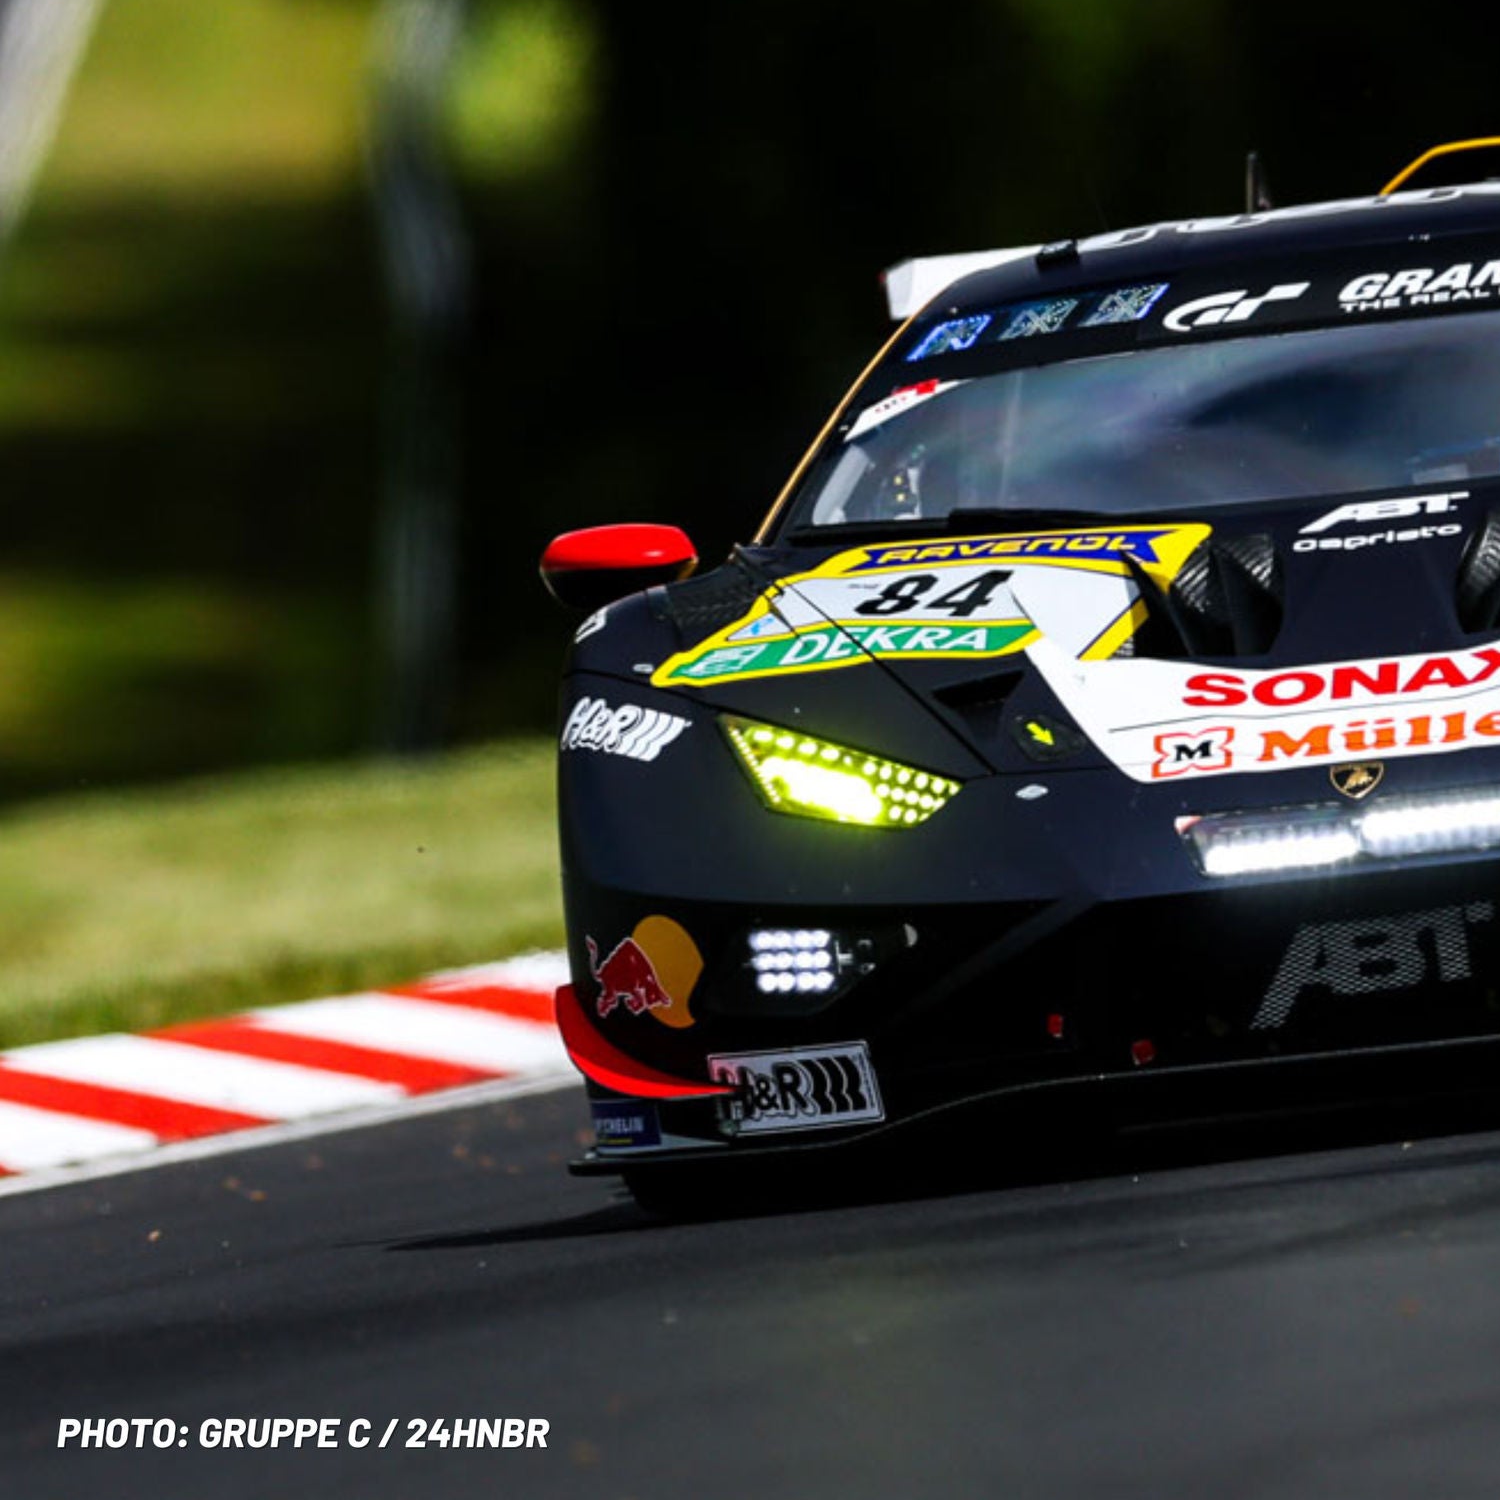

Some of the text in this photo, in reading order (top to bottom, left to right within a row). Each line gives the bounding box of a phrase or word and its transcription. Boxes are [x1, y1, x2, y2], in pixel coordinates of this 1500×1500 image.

[1339, 296, 1400, 313] THE
[1410, 282, 1490, 306] REAL
[1298, 491, 1470, 534] ABT
[877, 536, 1136, 564] RAVENOL
[853, 570, 1015, 617] 84
[778, 627, 989, 666] DEKRA
[1250, 901, 1495, 1030] ABT
